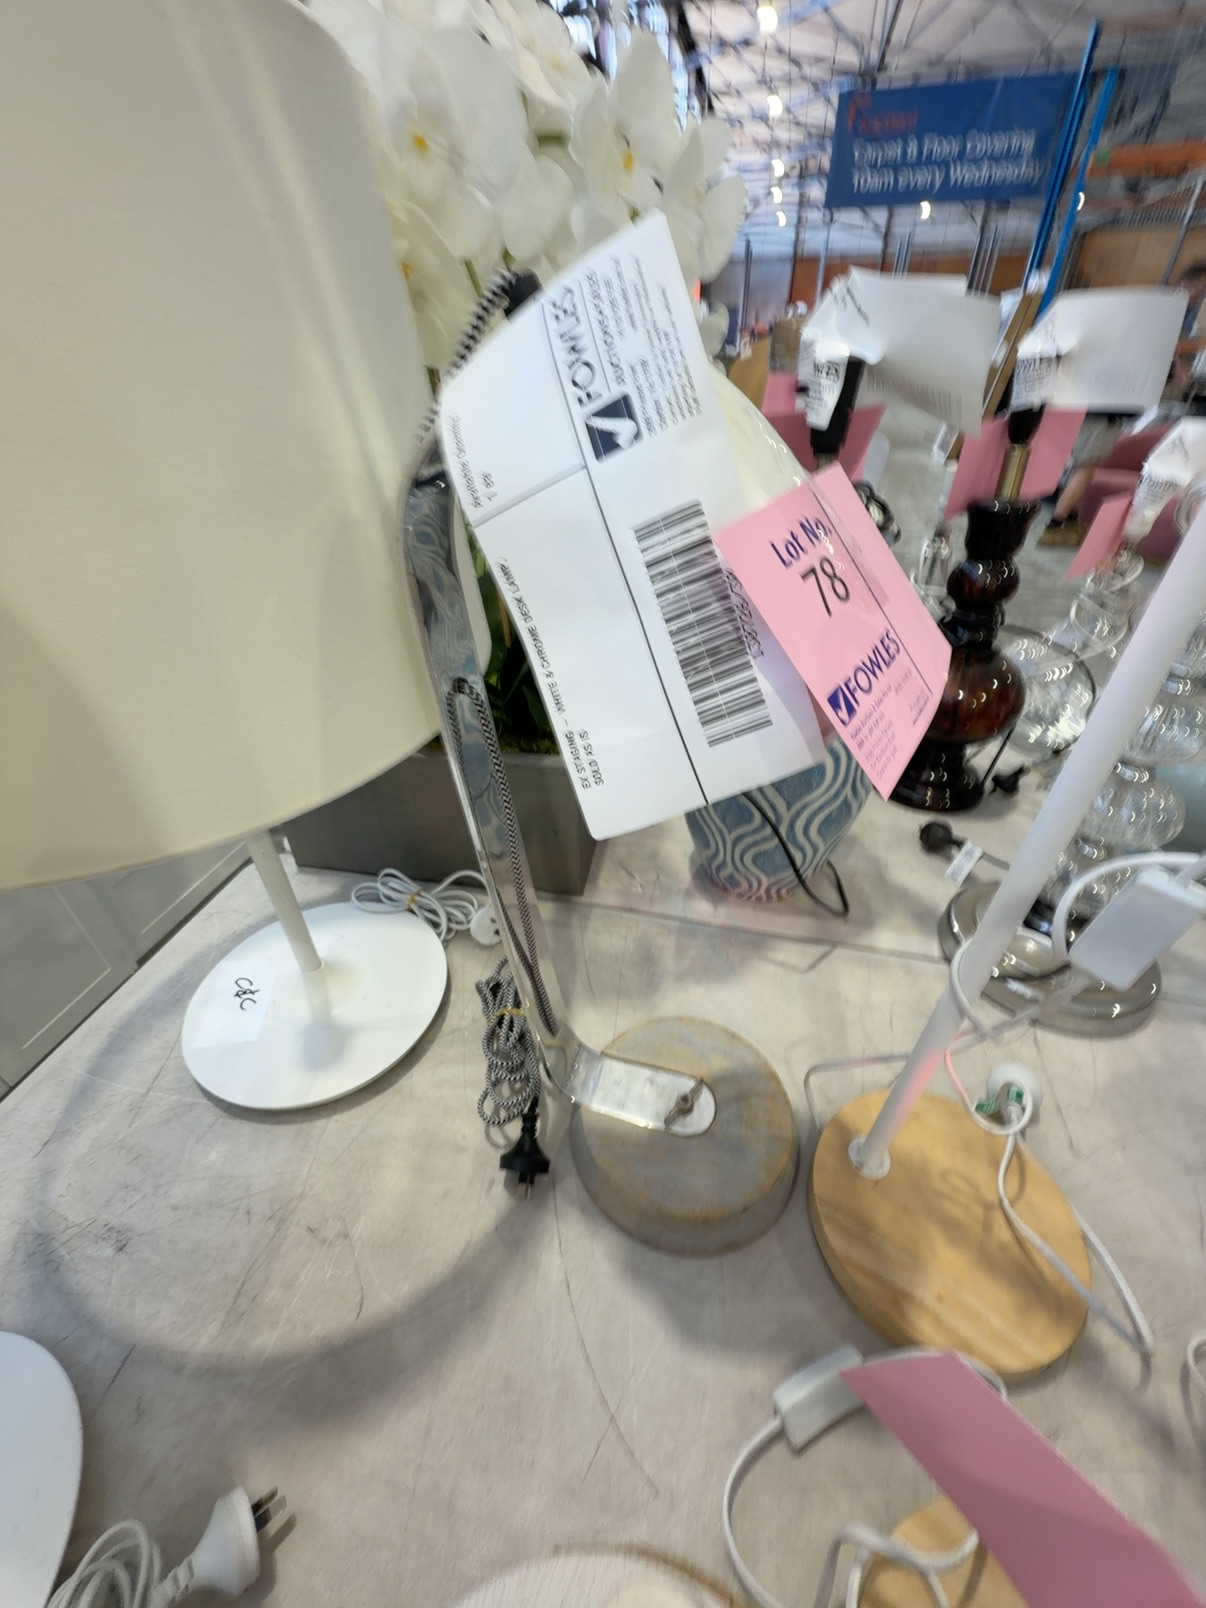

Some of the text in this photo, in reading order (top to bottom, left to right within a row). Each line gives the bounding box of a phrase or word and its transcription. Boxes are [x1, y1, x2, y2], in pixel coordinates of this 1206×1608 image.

[853, 137, 903, 169] Carpet
[922, 131, 964, 162] Floor
[965, 127, 1036, 160] Covering
[897, 165, 945, 195] every
[949, 157, 1045, 189] Wednesday
[551, 284, 603, 406] FOWLES
[768, 515, 832, 569] Lot No.
[513, 596, 533, 623] DESK
[800, 556, 850, 618] 78
[527, 625, 551, 668] CHROME
[844, 629, 901, 708] FOWLES
[548, 681, 566, 715] WHITE
[564, 729, 586, 774] STAGING
[578, 729, 604, 786] SOLD AS IS
